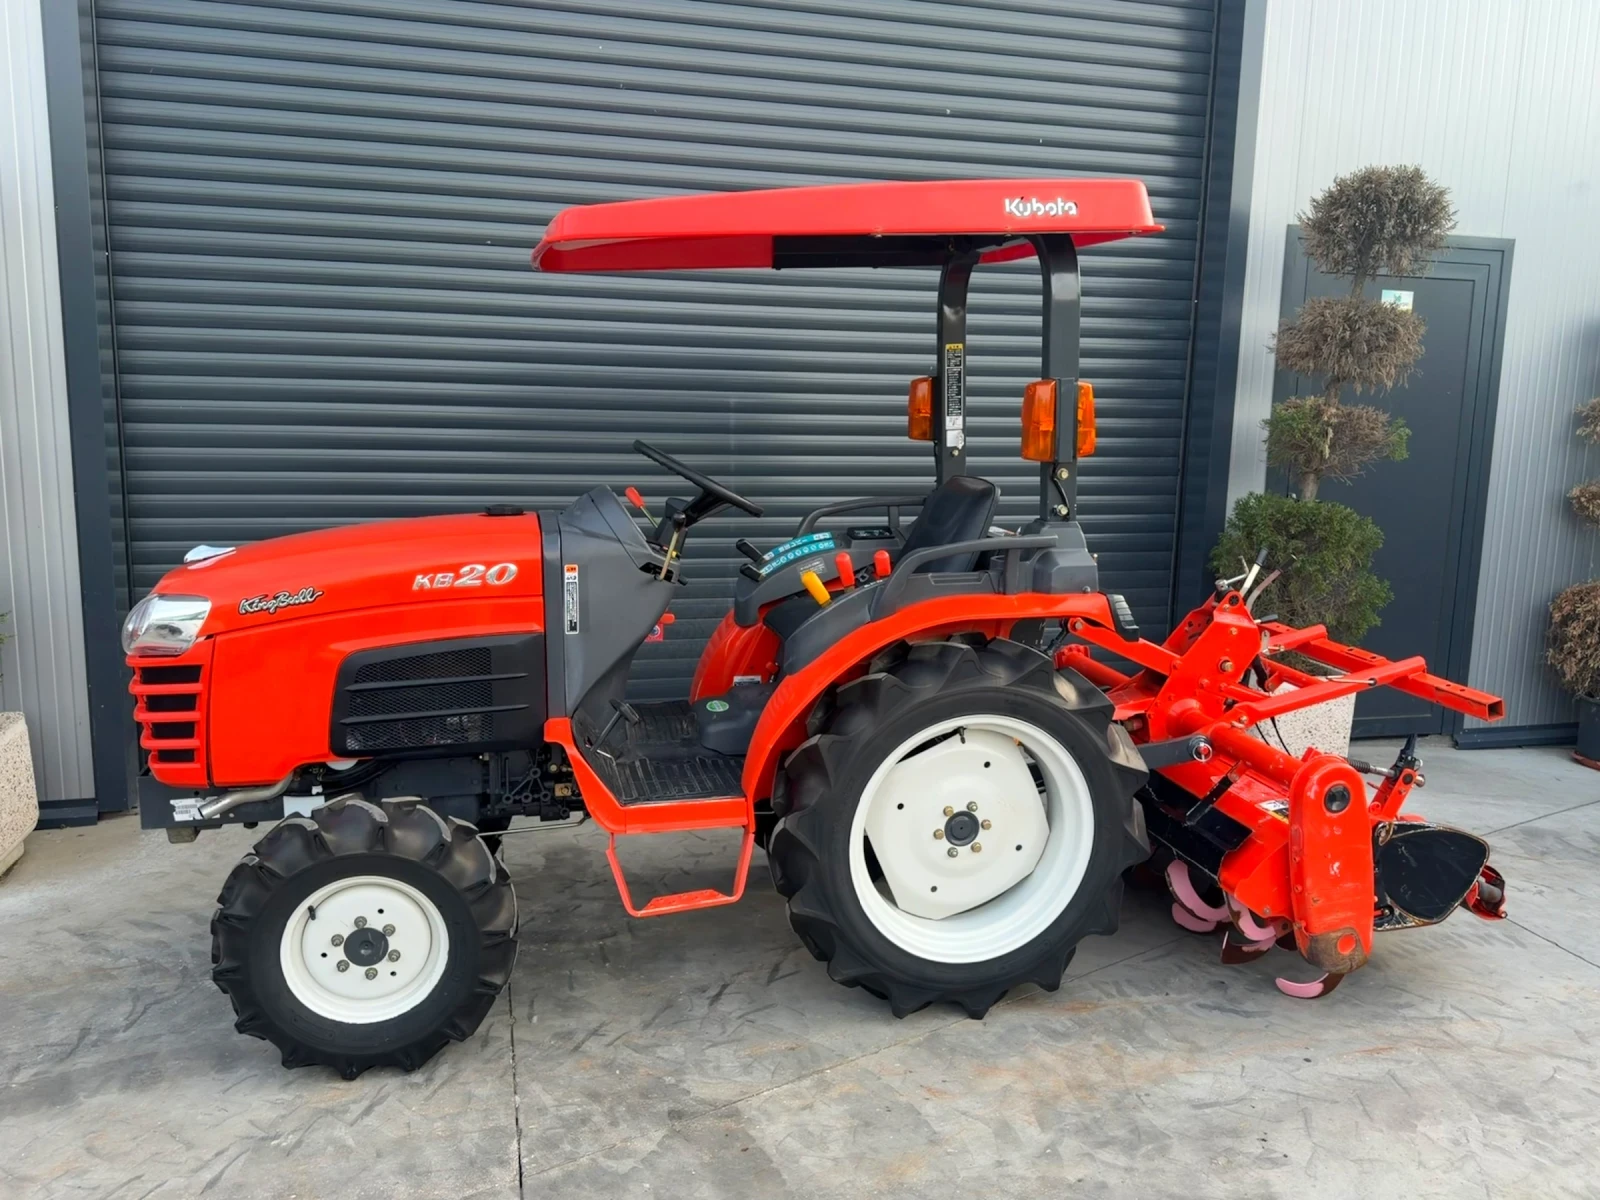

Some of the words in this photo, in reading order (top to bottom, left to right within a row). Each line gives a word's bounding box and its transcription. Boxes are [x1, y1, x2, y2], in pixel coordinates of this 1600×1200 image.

[1004, 197, 1078, 217] Kubota
[411, 562, 518, 591] KB20
[239, 587, 324, 614] KingBull
